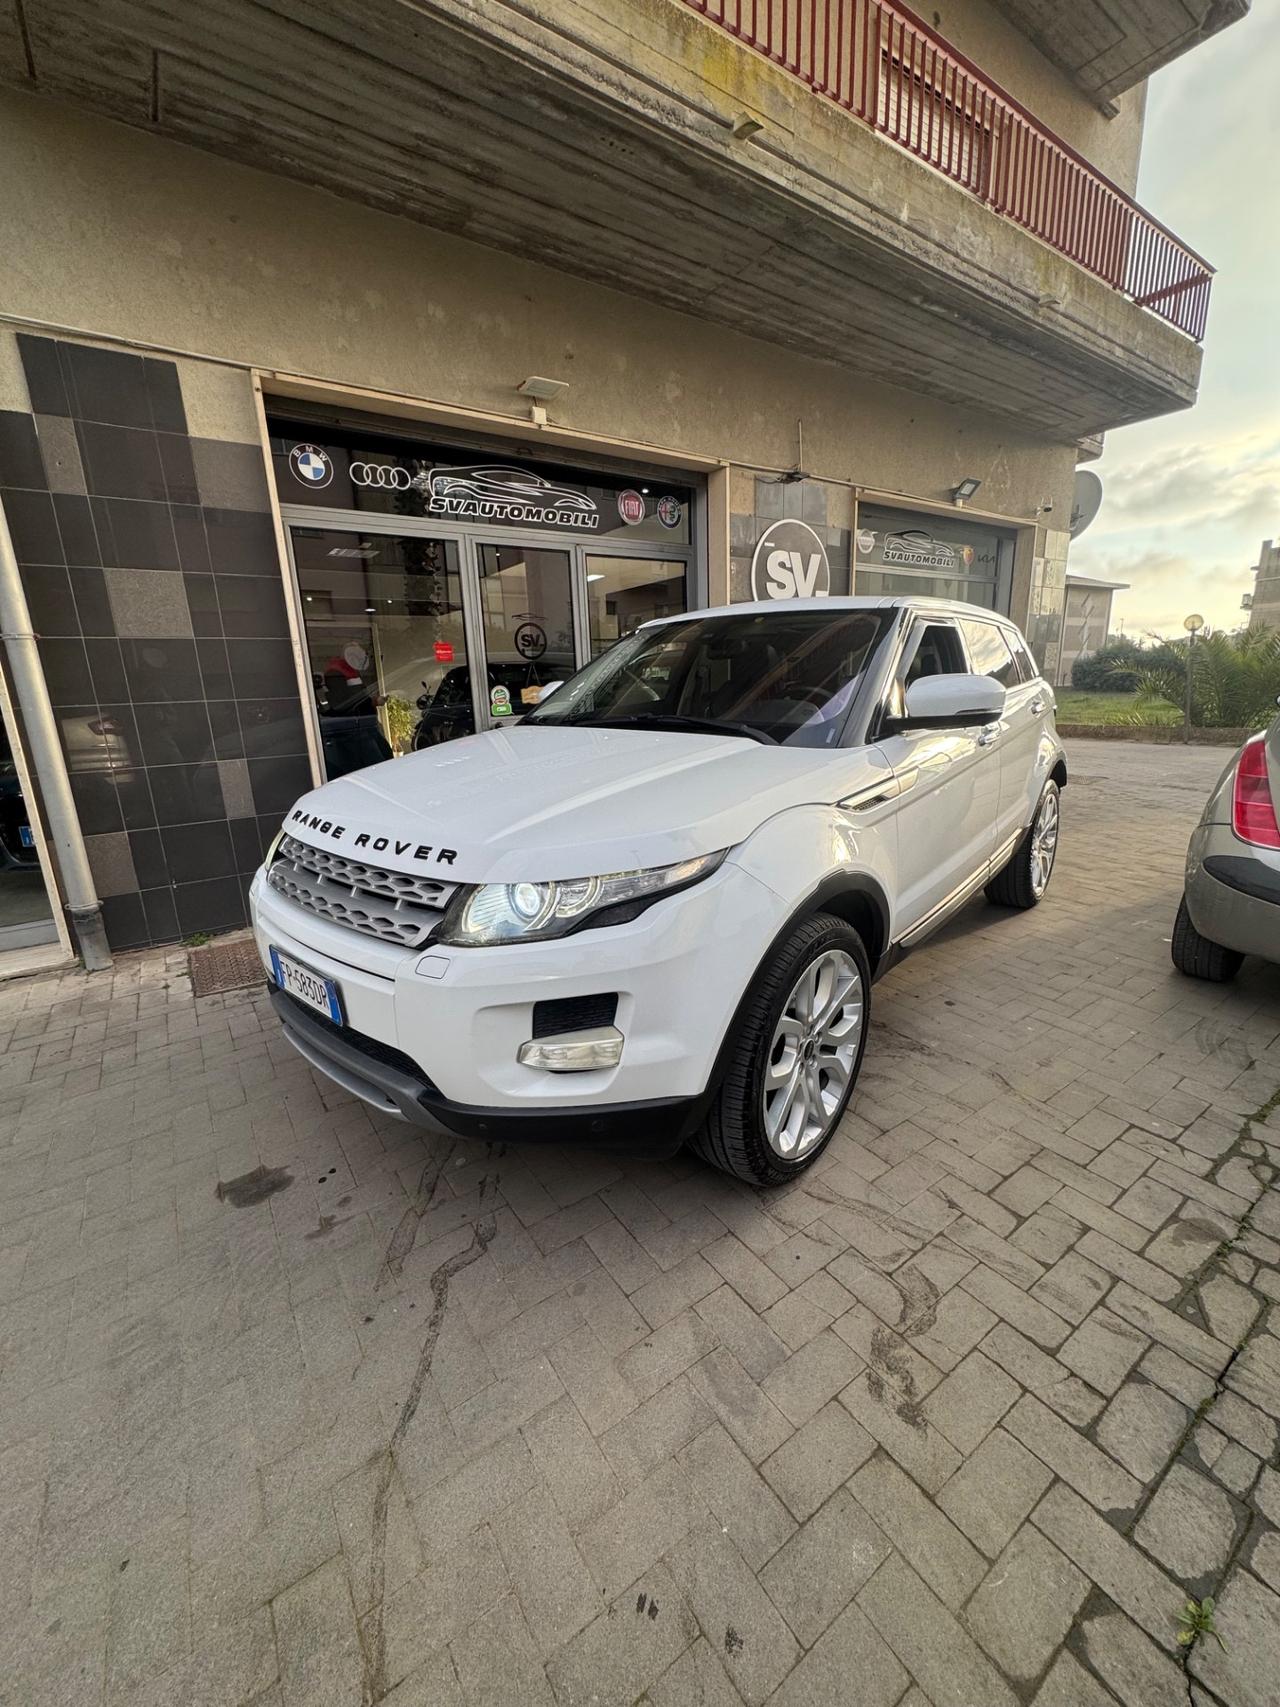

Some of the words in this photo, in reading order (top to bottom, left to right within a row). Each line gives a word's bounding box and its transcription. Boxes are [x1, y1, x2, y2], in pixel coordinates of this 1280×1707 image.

[293, 446, 328, 462] BMW
[429, 497, 599, 528] SVAUTOMOBILI
[883, 550, 955, 568] SVAUTOMOBILI
[292, 810, 346, 839] RANGE
[354, 833, 458, 865] ROVER
